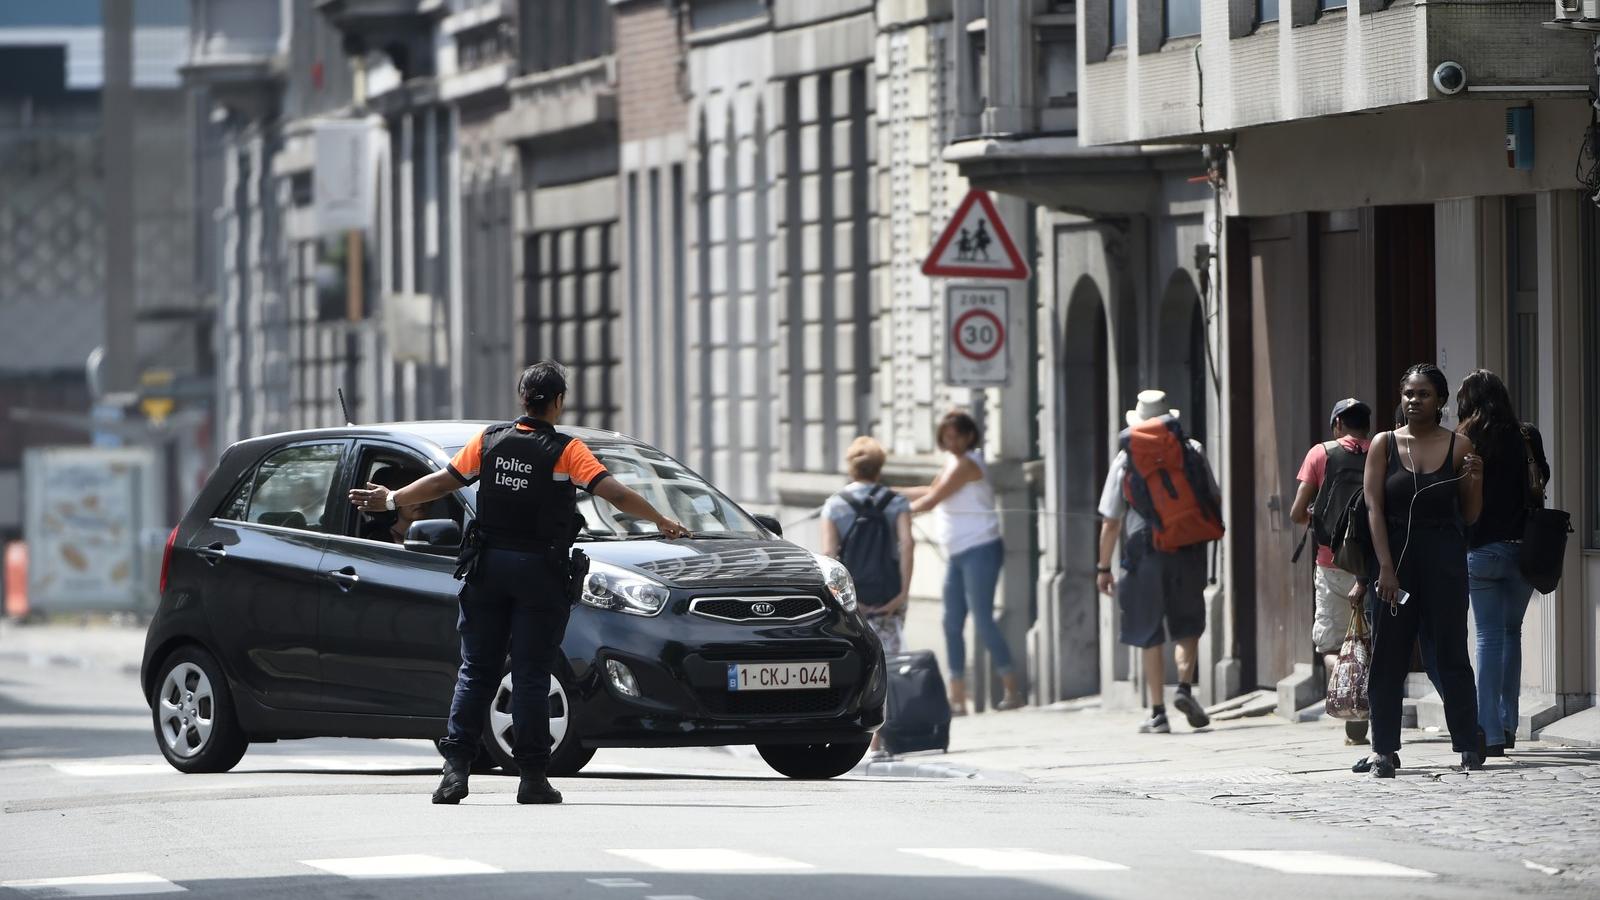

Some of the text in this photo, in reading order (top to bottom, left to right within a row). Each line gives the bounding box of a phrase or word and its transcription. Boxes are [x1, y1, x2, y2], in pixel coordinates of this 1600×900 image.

[960, 294, 996, 306] ZONE
[964, 325, 994, 345] 30
[495, 456, 533, 474] Police
[495, 472, 529, 491] Liege
[755, 604, 772, 612] KIA
